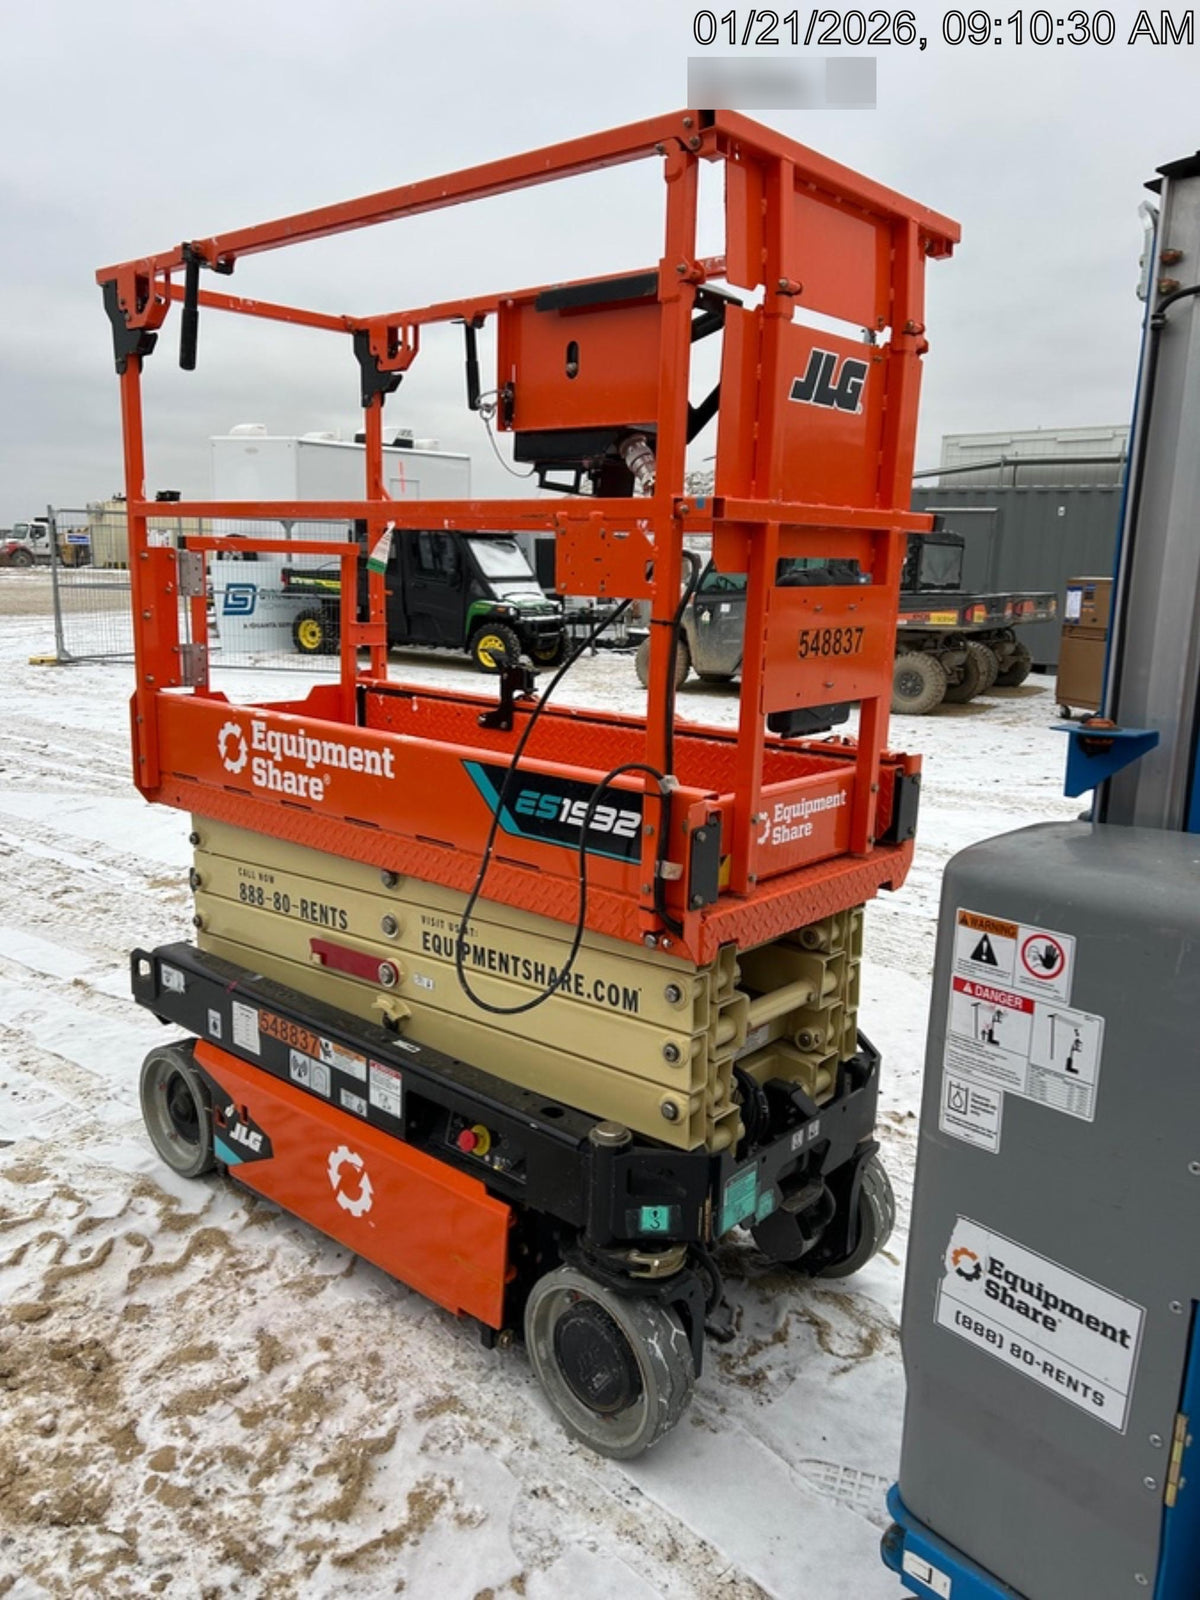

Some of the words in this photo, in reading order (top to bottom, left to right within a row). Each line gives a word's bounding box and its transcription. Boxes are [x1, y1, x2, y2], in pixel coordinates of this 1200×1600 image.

[788, 348, 869, 413] JLG
[798, 627, 864, 658] 548837
[251, 719, 395, 779] Equipment
[774, 789, 847, 824] Equipment
[772, 822, 813, 845] Share
[238, 867, 256, 880] CALL
[239, 882, 348, 930] 888-80-RENTS
[421, 915, 445, 929] VISIT
[970, 917, 1018, 937] WARNING
[422, 931, 639, 1013] EQUPMENTSHARE.COM
[975, 983, 1024, 1009] DANGER
[260, 1011, 319, 1057] 548837
[229, 1122, 263, 1152] JLG
[984, 1279, 1058, 1332] Share
[988, 1256, 1132, 1349] Equipment
[955, 1310, 1005, 1349] (888)
[1010, 1342, 1105, 1407] 80-RENTS
